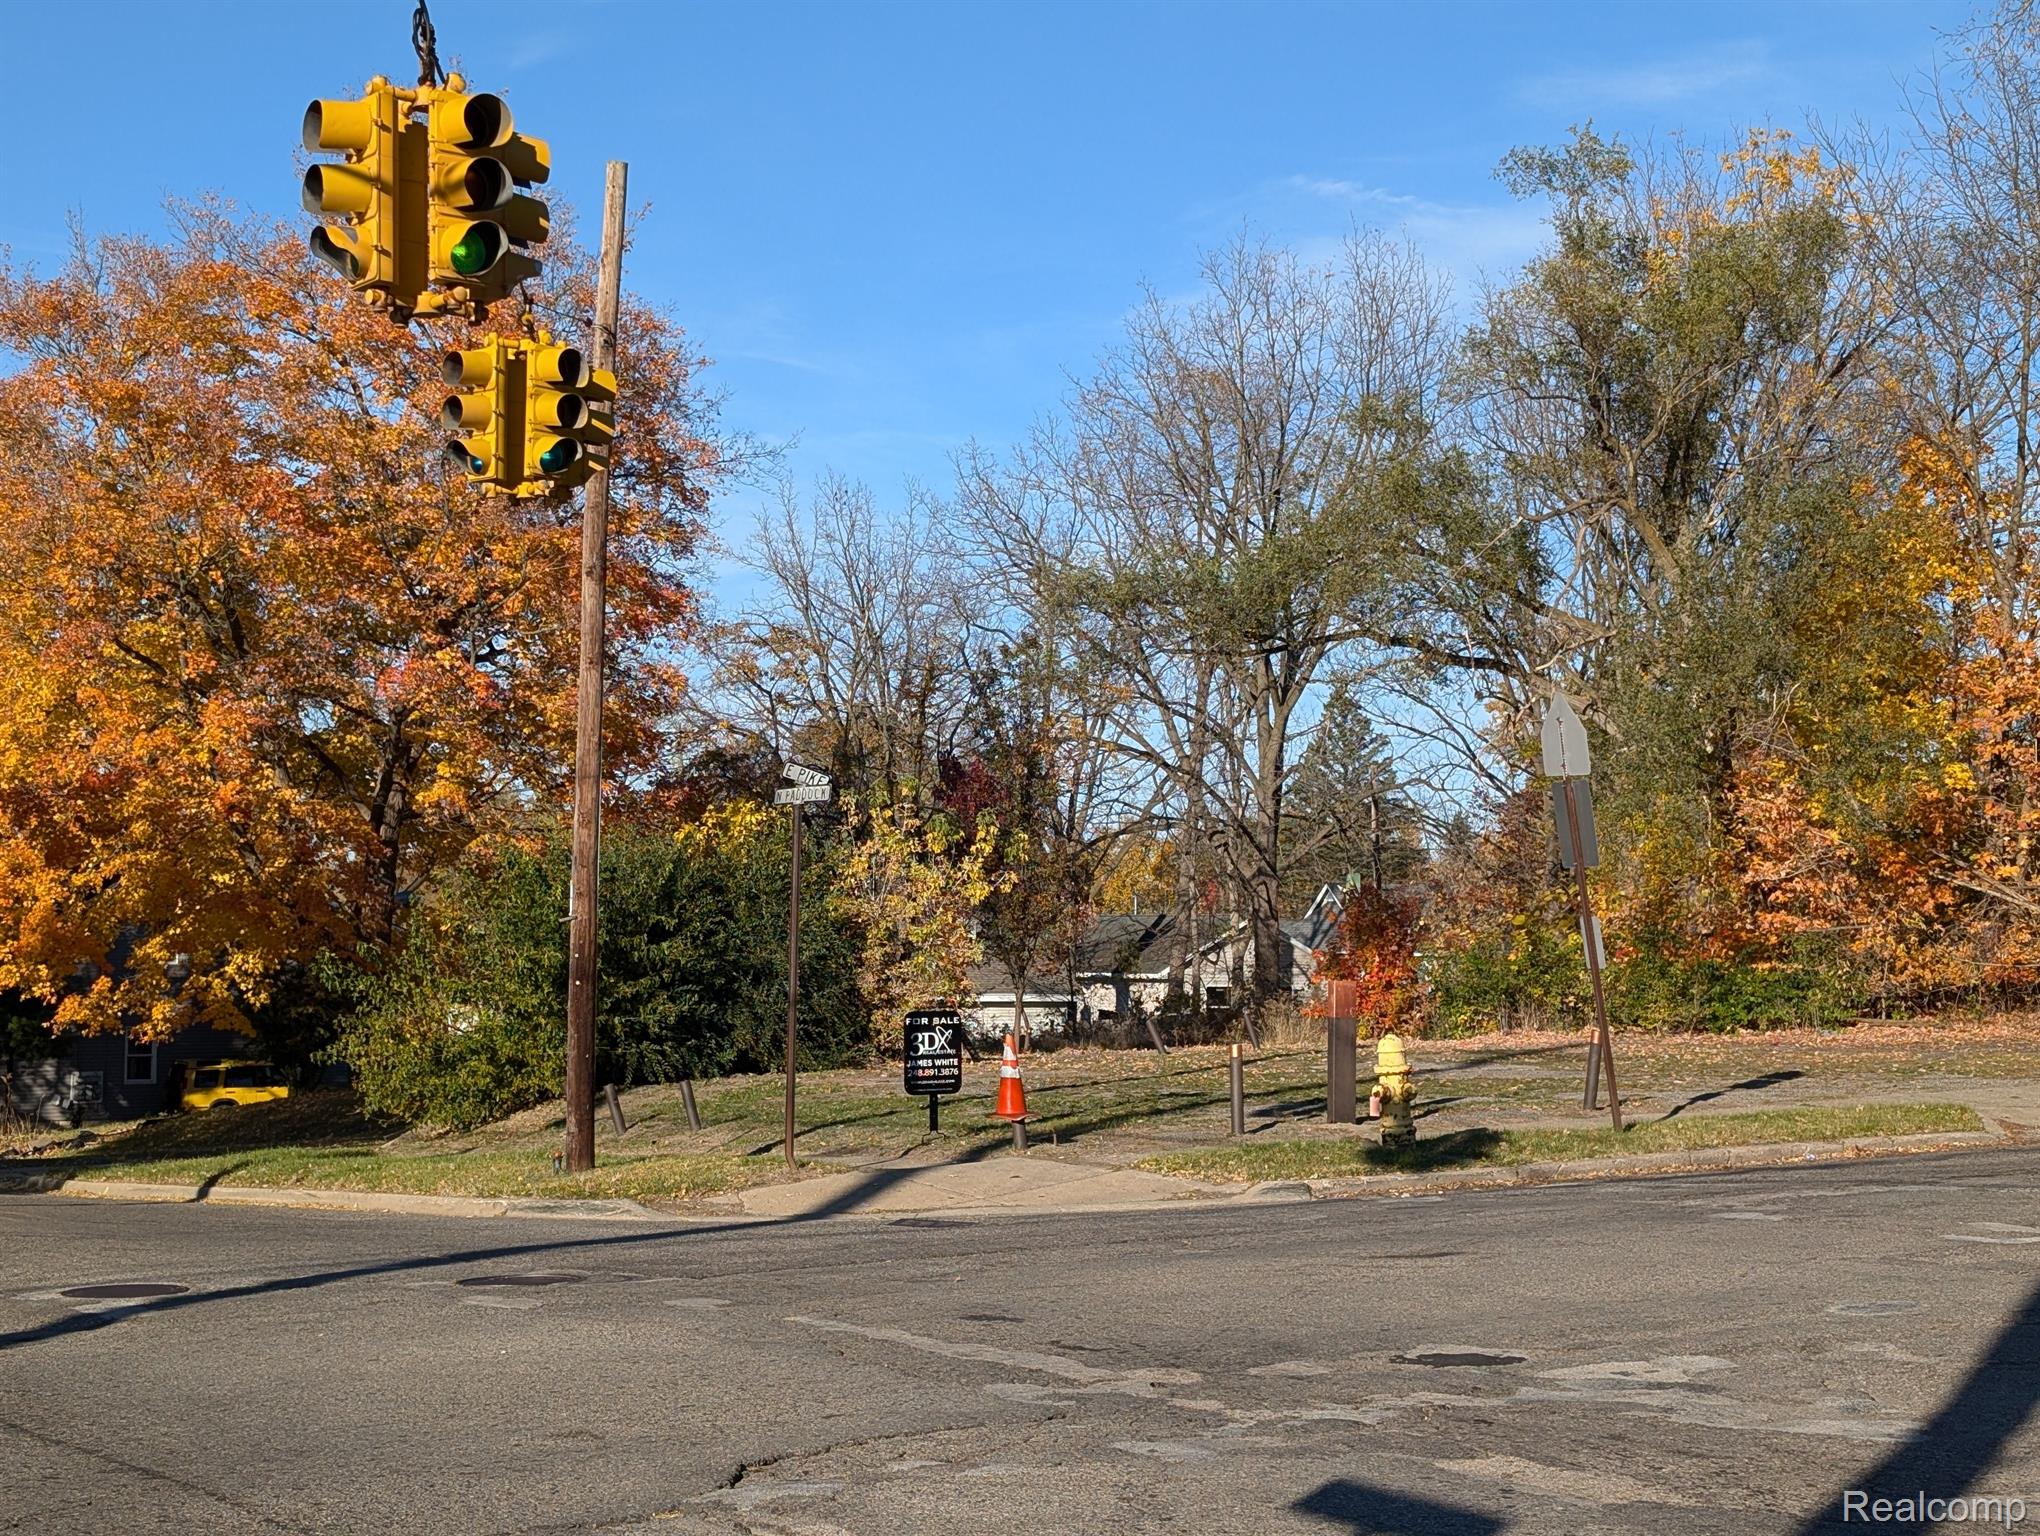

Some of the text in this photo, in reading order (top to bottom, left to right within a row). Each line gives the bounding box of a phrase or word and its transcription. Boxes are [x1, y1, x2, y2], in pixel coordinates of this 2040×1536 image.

[786, 764, 827, 786] E PIKE
[776, 787, 827, 802] N PADDOCK
[906, 1016, 960, 1026] FOR SALE
[906, 1058, 958, 1068] JAMES WHITE
